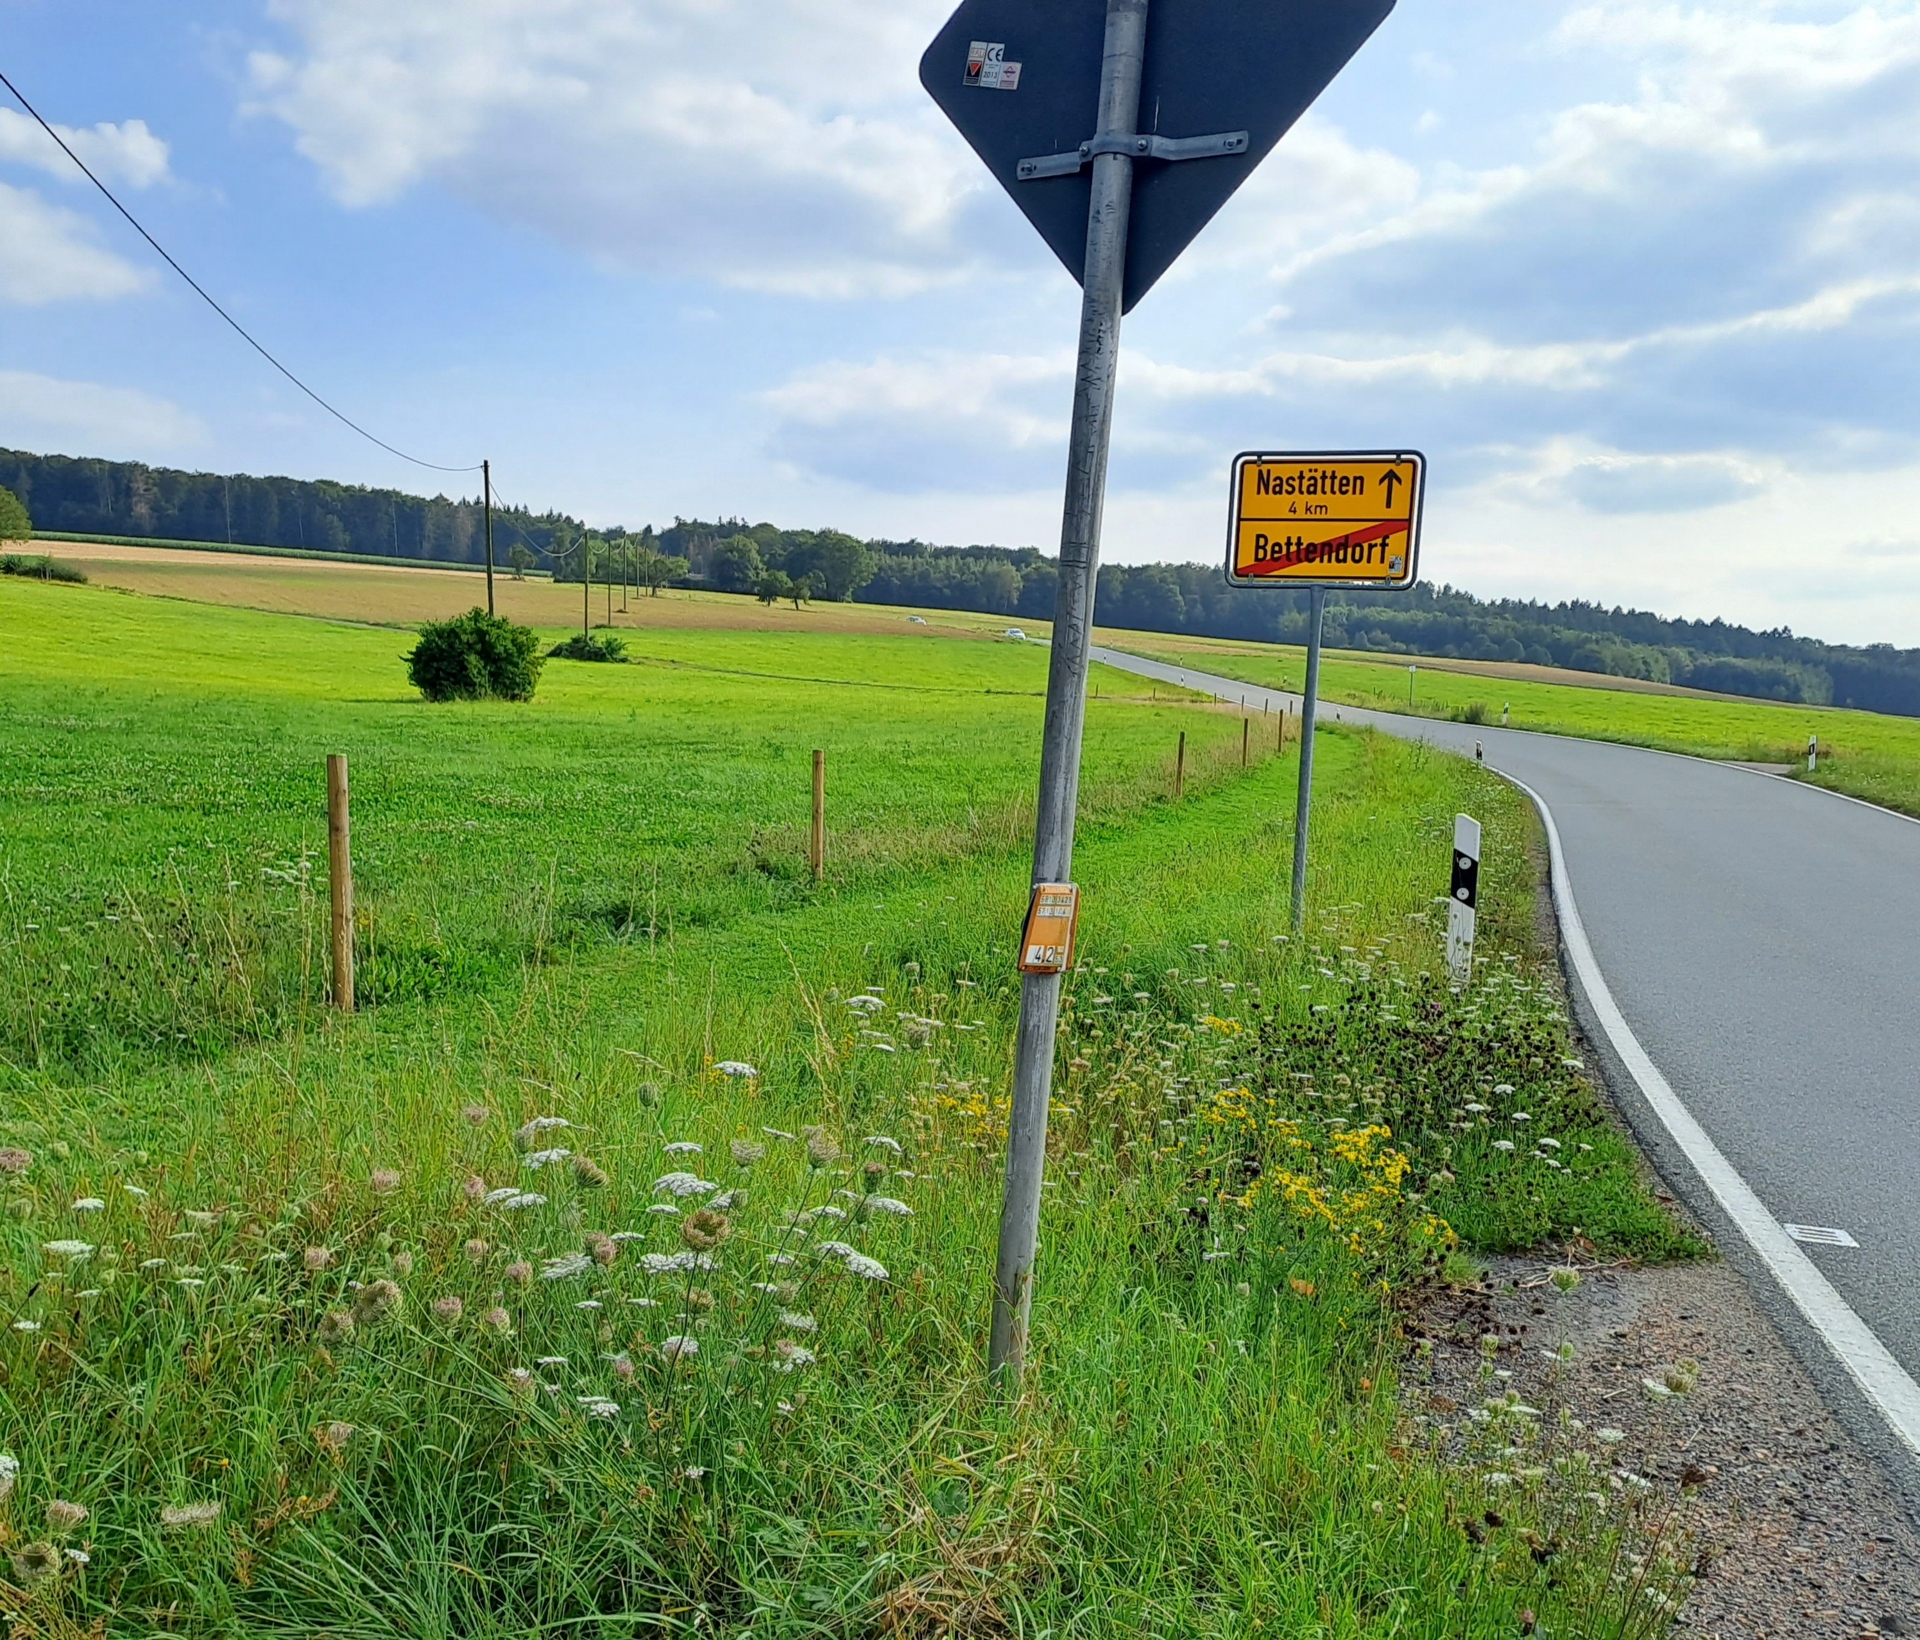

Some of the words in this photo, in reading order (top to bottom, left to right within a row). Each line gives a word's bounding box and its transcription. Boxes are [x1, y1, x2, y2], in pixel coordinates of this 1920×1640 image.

[987, 47, 1004, 62] CE
[1256, 468, 1365, 496] Nastätten
[1288, 501, 1298, 515] 4
[1304, 501, 1329, 515] km
[1253, 533, 1390, 564] Bettendorf
